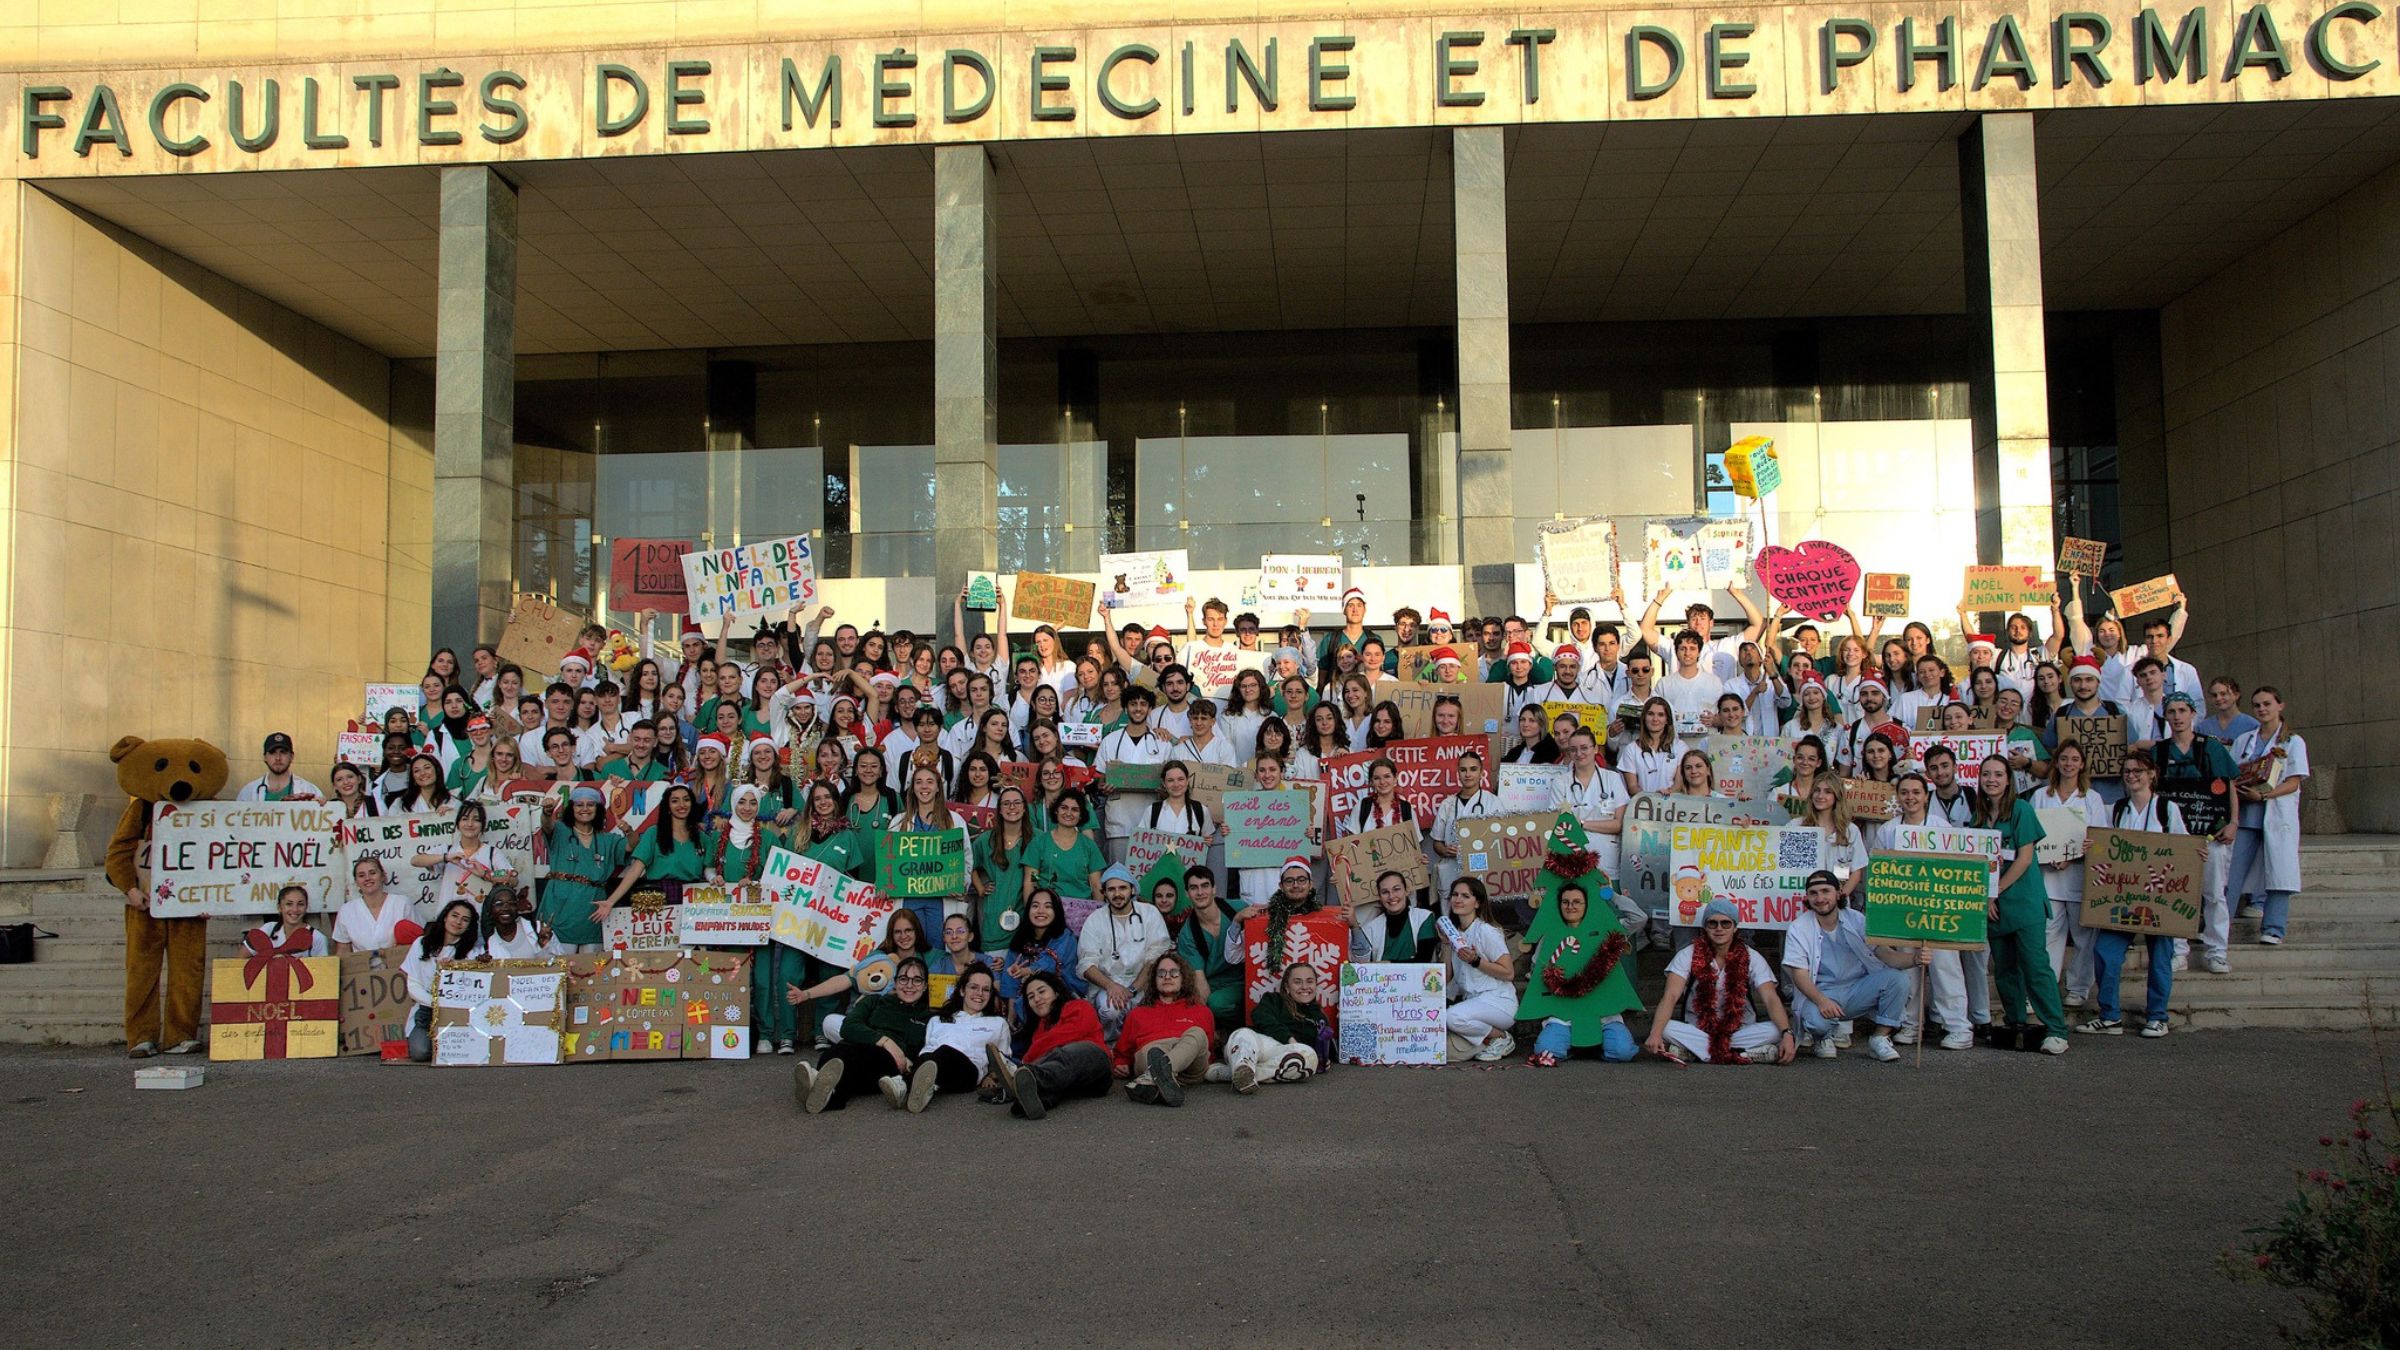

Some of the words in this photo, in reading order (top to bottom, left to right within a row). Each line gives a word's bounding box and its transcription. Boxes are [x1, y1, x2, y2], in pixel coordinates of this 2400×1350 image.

[23, 67, 527, 158] FACULTÉS
[597, 61, 712, 136] DE
[781, 46, 1356, 131] MÉDECINE
[1437, 29, 1557, 107] ET
[1628, 23, 1758, 101] DE
[1819, 0, 2400, 95] PHARMAC
[702, 547, 764, 577] NOEL
[773, 537, 810, 564] DES
[716, 562, 802, 595] ENFANTS
[1774, 566, 1845, 585] CHAQUE
[720, 580, 814, 615] MALADES
[1796, 595, 1848, 612] COMPTE
[1968, 592, 2015, 605] ENFANTS
[2071, 717, 2118, 733] NOEL
[2080, 732, 2107, 745] DES
[1385, 745, 1428, 764] CETTE
[2083, 744, 2128, 758] FANTS
[2090, 758, 2125, 775] ADES
[1398, 769, 1441, 787] OYEZ
[1267, 799, 1290, 811] des
[1846, 790, 1887, 801] NFANTS
[1634, 796, 1700, 822] Aidez
[1852, 804, 1887, 815] LADES
[172, 812, 196, 827] ET
[290, 808, 335, 832] VOUS
[382, 825, 402, 840] DES
[409, 819, 456, 839] ENFANTS
[881, 832, 896, 859] 1
[900, 836, 943, 857] PETIT
[1176, 836, 1204, 852] DON
[1376, 830, 1417, 860] DON
[1490, 838, 1502, 860] 1
[1503, 835, 1542, 860] DON
[1673, 826, 1769, 851] ENFANTS
[1902, 830, 1937, 850] SANS
[1942, 833, 1974, 853] VOUS
[1978, 834, 1999, 855] PAS
[162, 842, 197, 871] LE
[208, 835, 267, 870] PÈRE
[273, 838, 327, 867] NOËL
[1699, 851, 1776, 872] MALADES
[2153, 848, 2174, 857] un
[770, 851, 822, 887] Noël
[882, 864, 896, 889] 1
[898, 861, 944, 876] GRAND
[1871, 859, 1913, 876] GRÂCE
[1932, 867, 1982, 883] VOTRE
[178, 883, 236, 903] CETTE
[251, 876, 307, 902] ANN
[319, 875, 332, 909] ?
[1486, 868, 1540, 897] SOURI
[1779, 876, 1808, 889] LEU
[1934, 883, 1949, 894] LES
[1951, 884, 1987, 896] ENFANTS
[1868, 892, 1941, 909] HOSPITALISÉS
[1943, 899, 1986, 911] SERONT
[2171, 898, 2197, 920] CHU
[631, 907, 676, 923] SOYEZ
[1905, 909, 1962, 932] GÂTÉS
[632, 921, 674, 936] LEUR
[695, 921, 736, 931] ENFANTS
[611, 1030, 692, 1050] MERCI
